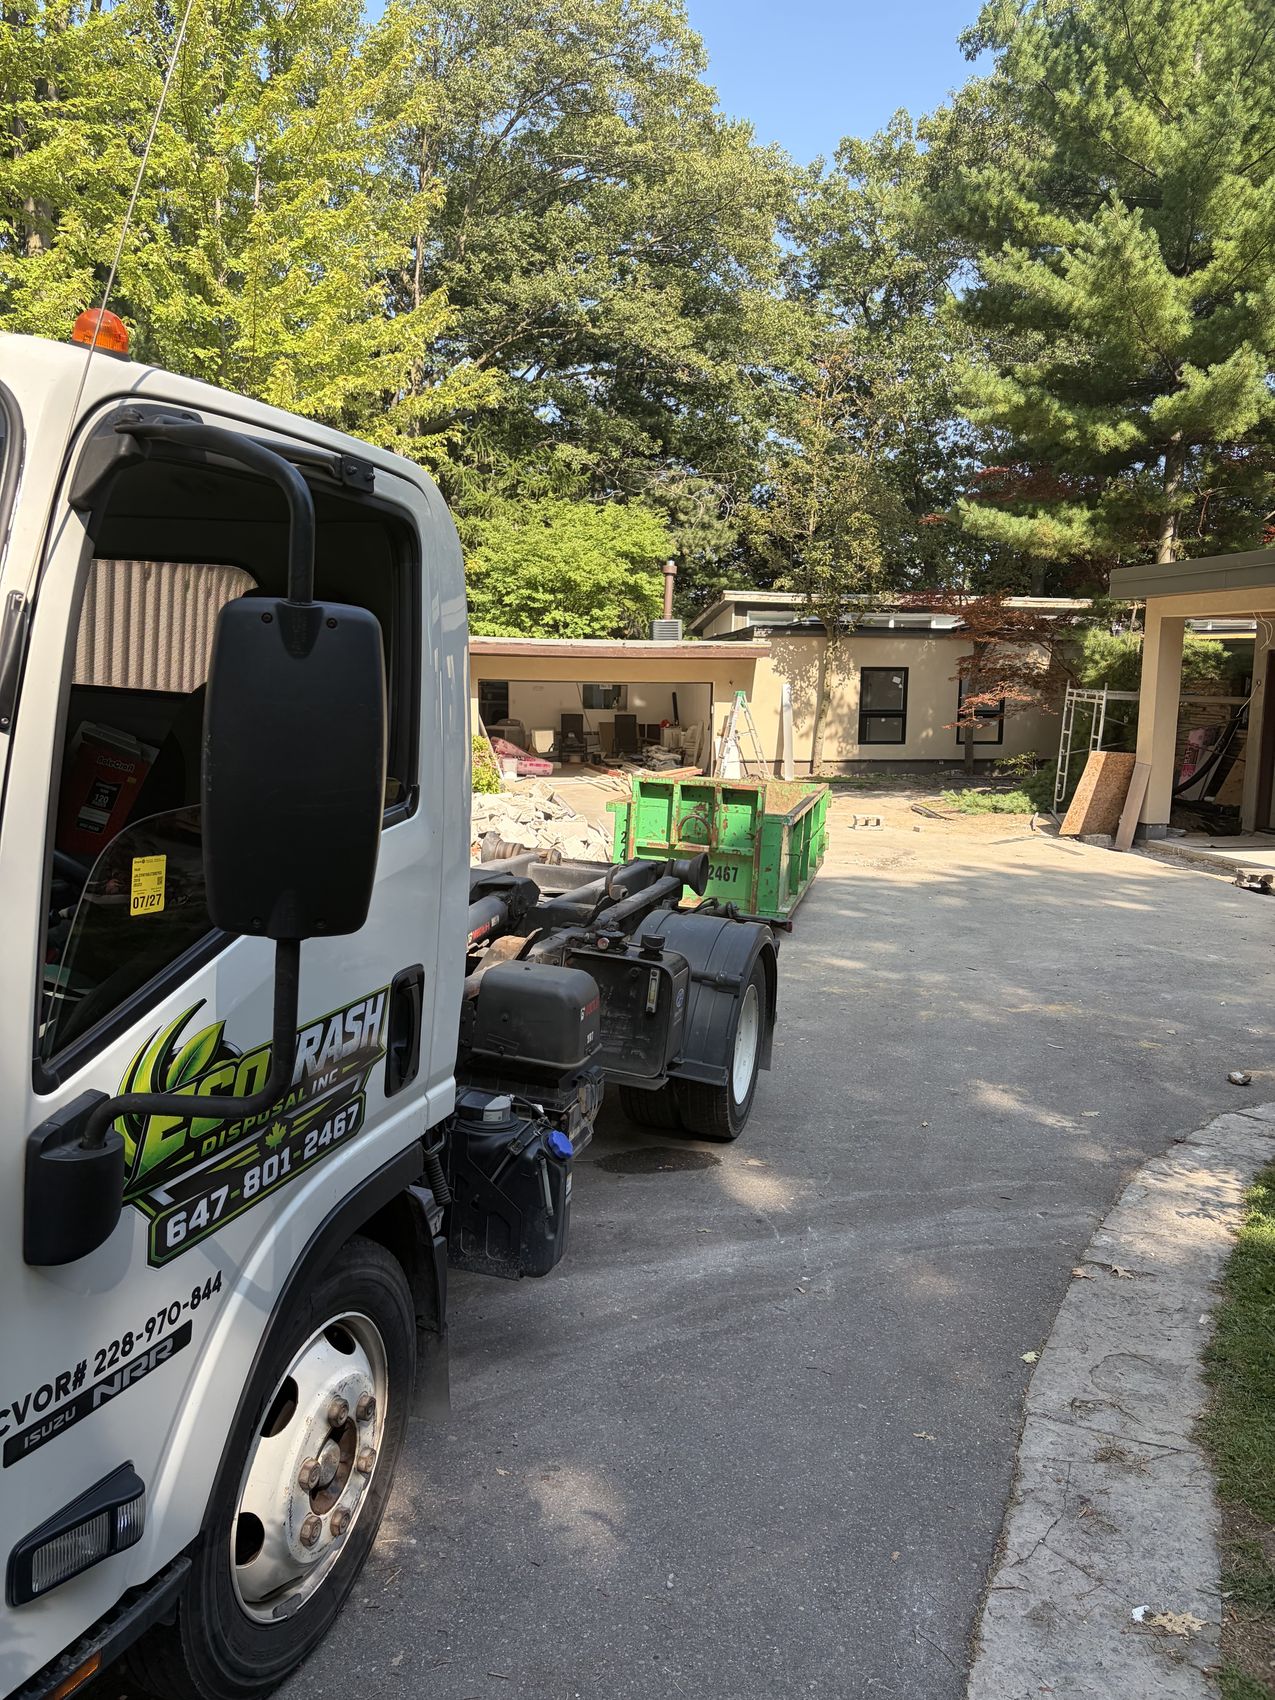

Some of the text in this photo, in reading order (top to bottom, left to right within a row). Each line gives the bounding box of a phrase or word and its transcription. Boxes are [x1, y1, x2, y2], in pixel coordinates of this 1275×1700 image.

[133, 893, 162, 910] 07/27
[708, 864, 738, 883] 2467
[292, 991, 386, 1085] RASH
[200, 1068, 338, 1158] DISPOSAL INC
[166, 1103, 361, 1248] 647-801-2467
[93, 1270, 222, 1378] 228-970-844
[24, 1338, 173, 1449] ISUZU NRR
